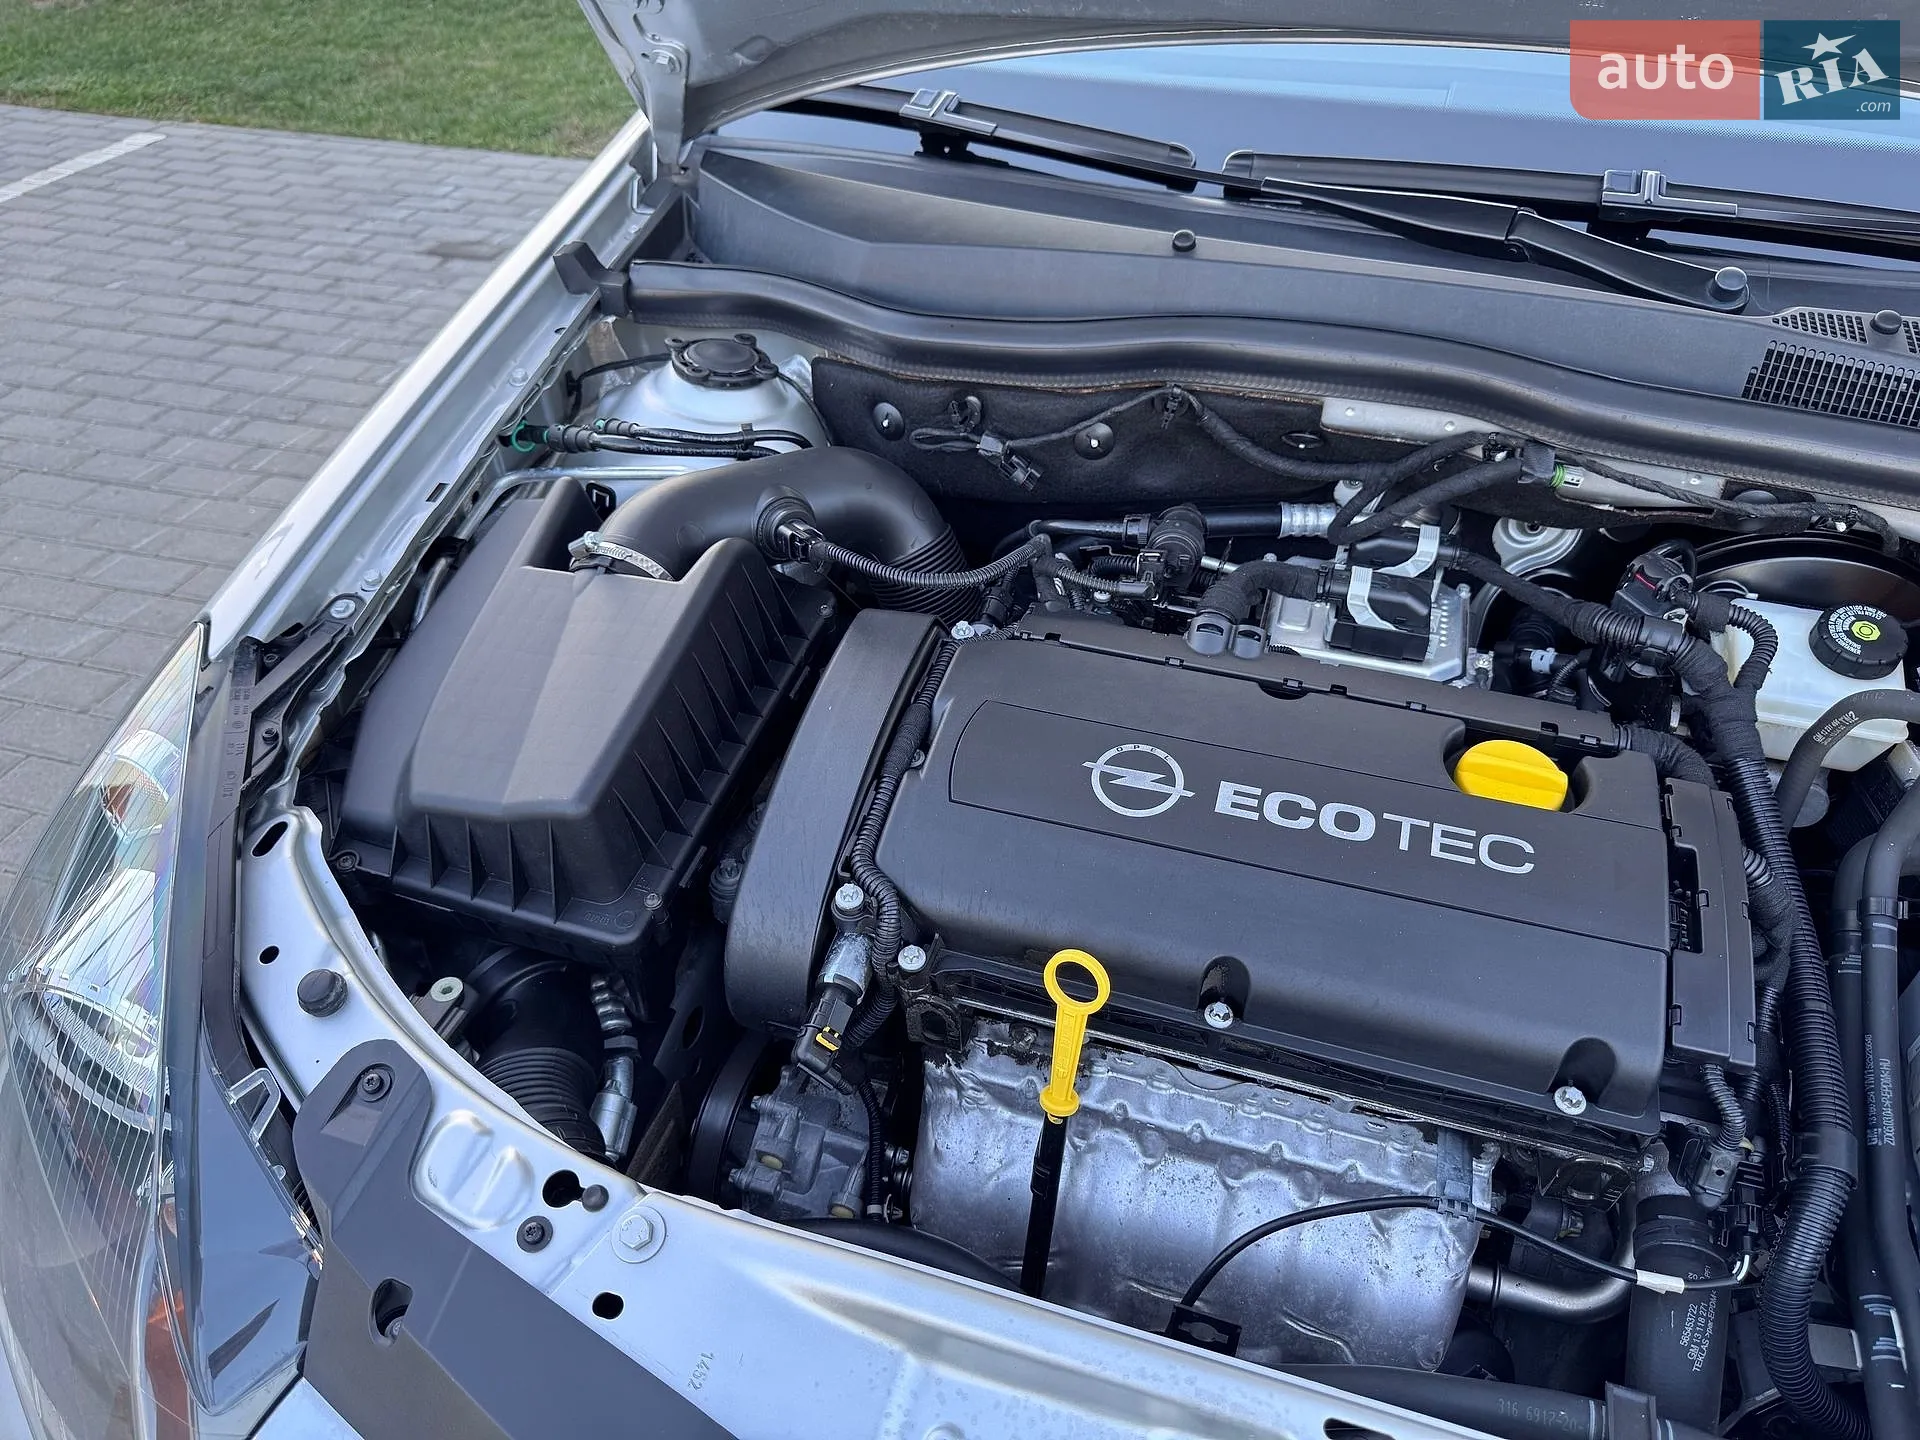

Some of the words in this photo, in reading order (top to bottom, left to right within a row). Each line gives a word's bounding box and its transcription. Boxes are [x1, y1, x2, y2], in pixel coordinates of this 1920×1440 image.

[1116, 744, 1169, 761] OPEL
[1214, 780, 1535, 874] ECOTEC
[1699, 1301, 1708, 1317] 271
[1680, 1303, 1698, 1347] 565453722
[1696, 1316, 1706, 1332] 118
[1693, 1332, 1702, 1343] 13
[1687, 1344, 1700, 1361] GM
[1692, 1338, 1710, 1372] TEKLAS
